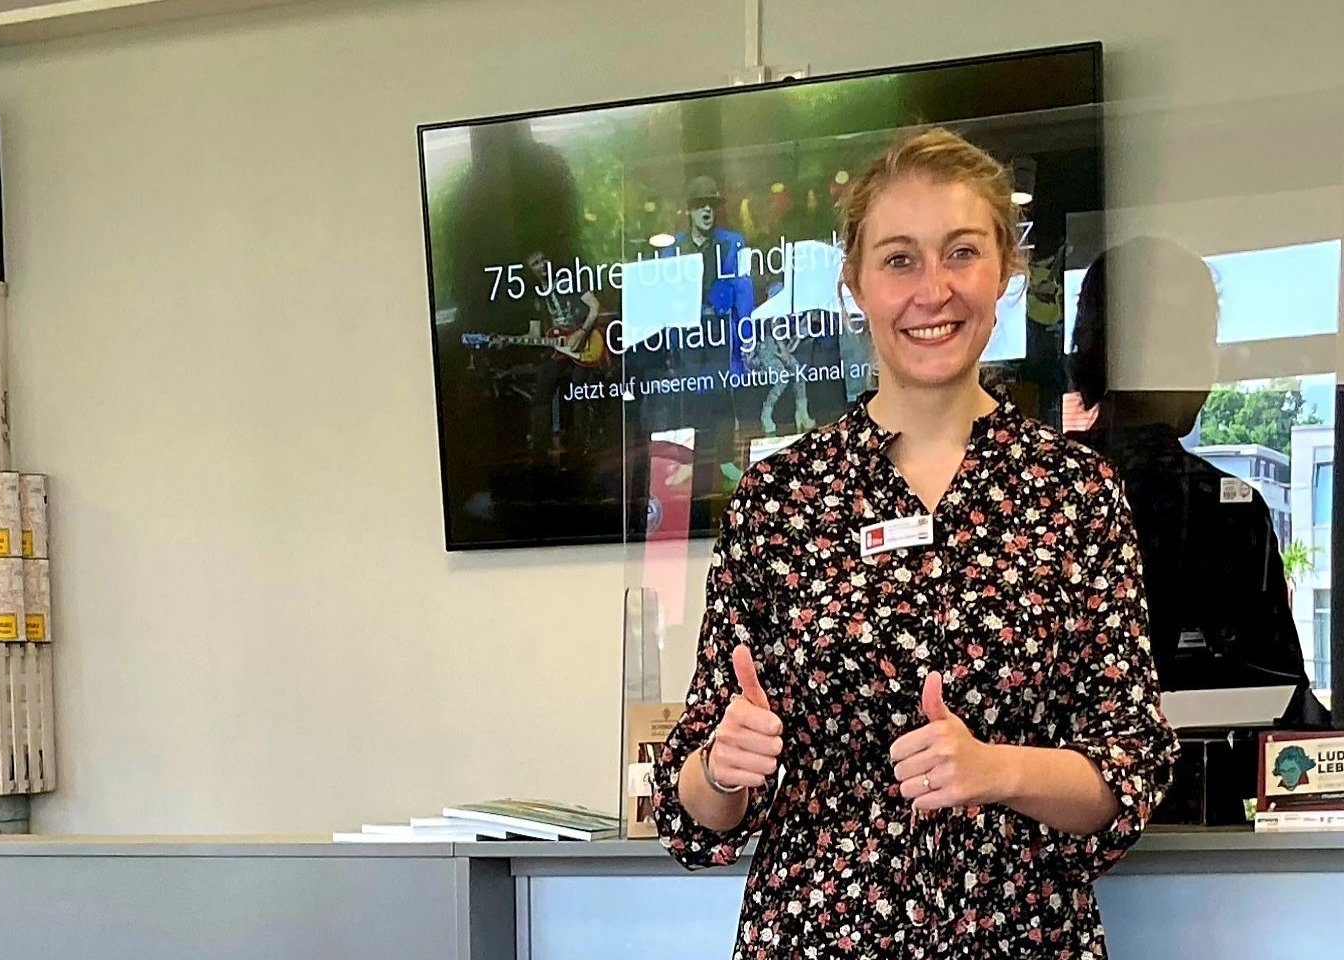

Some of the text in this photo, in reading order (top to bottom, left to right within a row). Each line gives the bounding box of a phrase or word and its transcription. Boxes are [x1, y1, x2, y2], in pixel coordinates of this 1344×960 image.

[484, 264, 526, 301] 75
[534, 256, 624, 298] Jahre
[606, 308, 867, 355] Gronau gratulie
[564, 360, 880, 401] Jetzt auf unserem Youtube-Kanal ans
